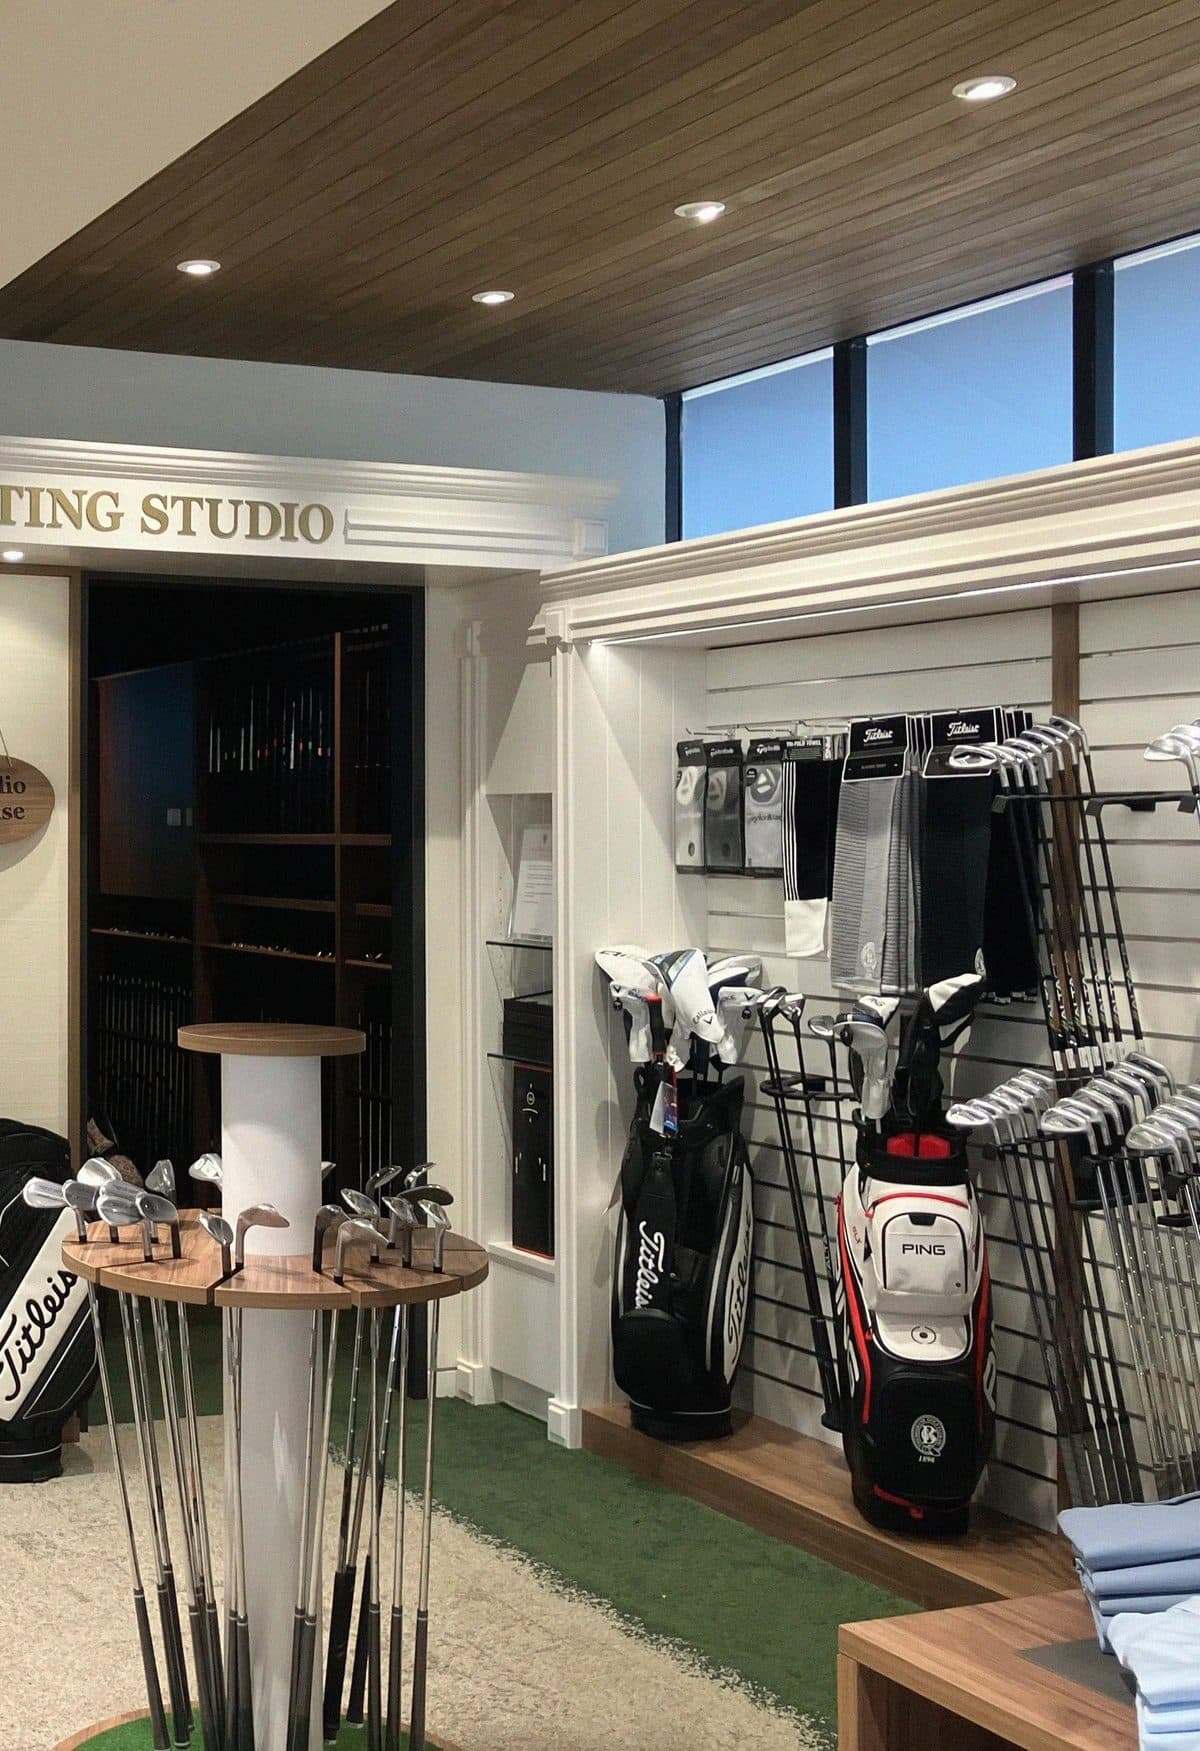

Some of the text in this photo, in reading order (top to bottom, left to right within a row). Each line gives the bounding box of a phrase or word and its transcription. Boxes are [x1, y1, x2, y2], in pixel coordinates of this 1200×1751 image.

[140, 493, 335, 544] STUDIO
[863, 727, 894, 743] Titleist
[947, 721, 980, 737] Titleist
[902, 1244, 946, 1256] PING
[635, 1220, 664, 1310] Titleis
